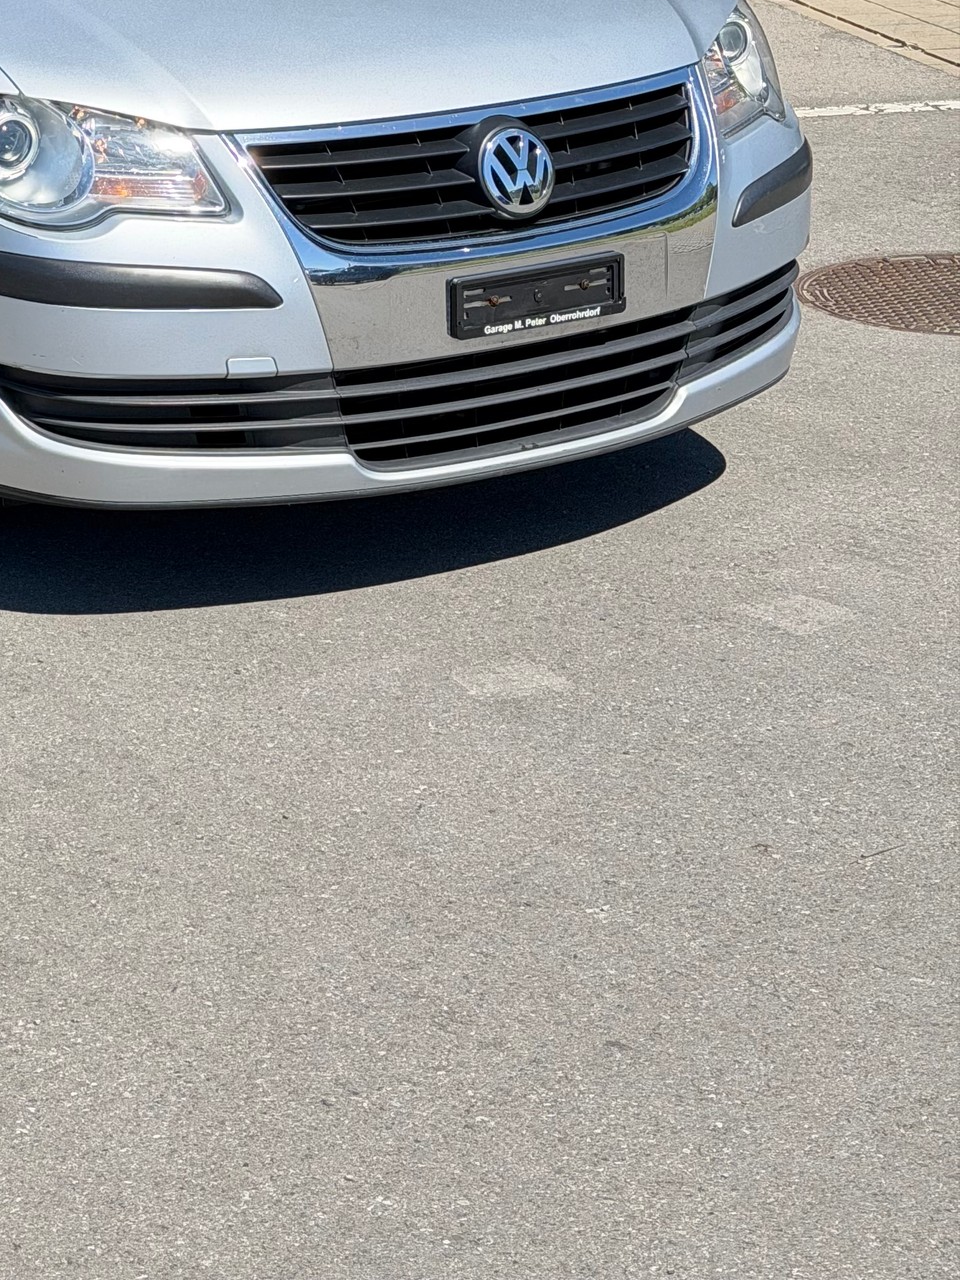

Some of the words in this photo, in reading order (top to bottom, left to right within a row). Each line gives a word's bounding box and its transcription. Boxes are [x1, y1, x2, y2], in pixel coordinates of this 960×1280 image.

[483, 128, 550, 213] VW
[484, 323, 513, 334] Garage
[514, 320, 524, 329] M.
[525, 317, 547, 328] Peter
[550, 306, 601, 323] Oberrohrdorf
